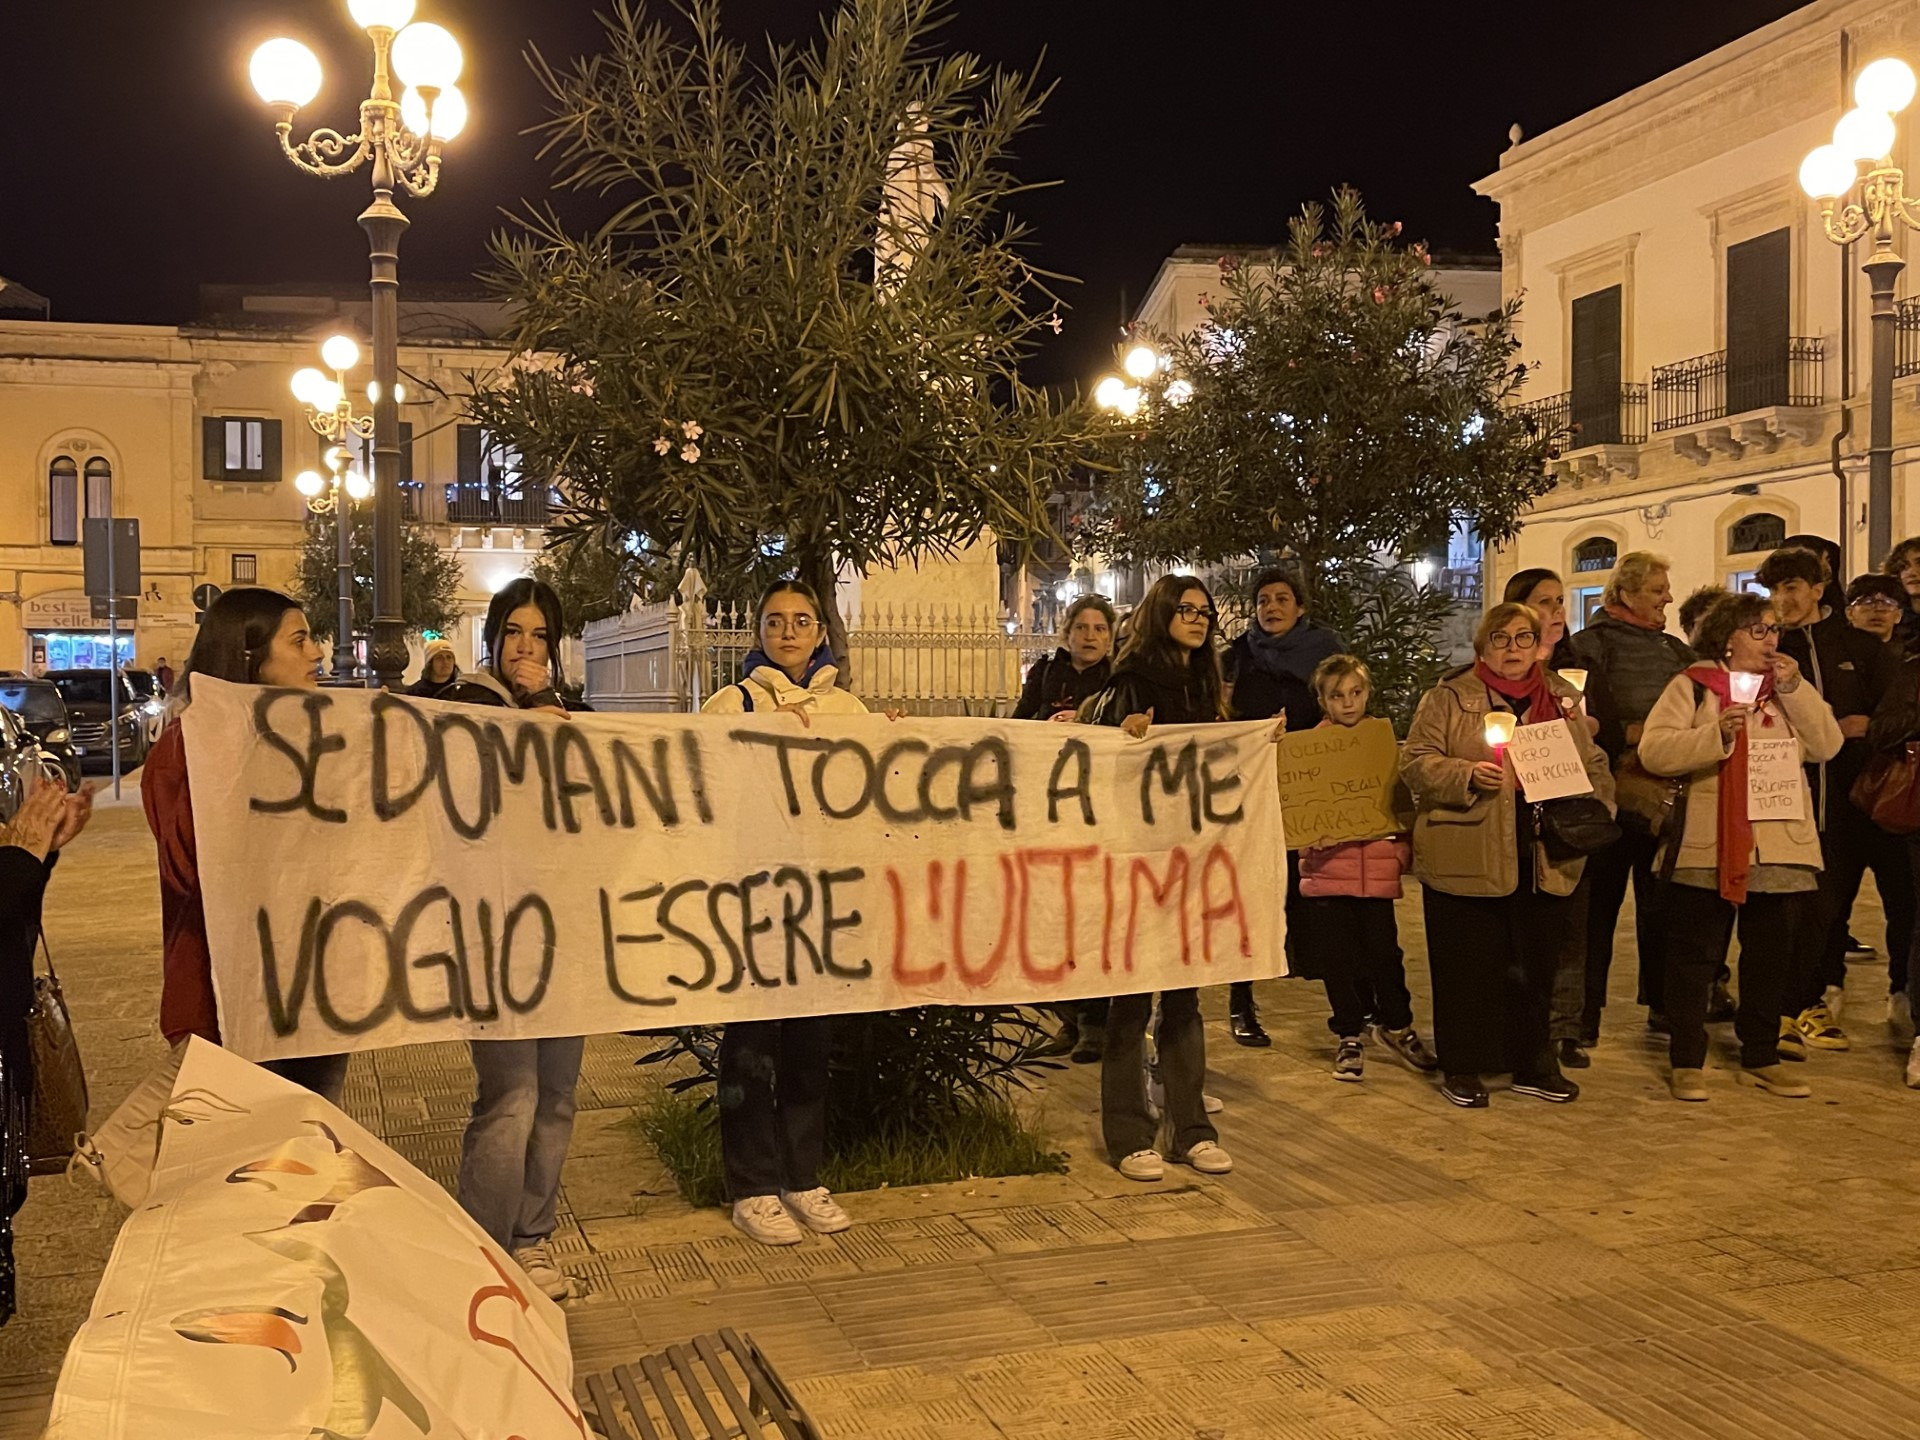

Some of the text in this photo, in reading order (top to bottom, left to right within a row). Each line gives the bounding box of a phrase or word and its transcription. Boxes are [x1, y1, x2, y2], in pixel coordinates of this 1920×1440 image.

[30, 601, 66, 613] best
[53, 614, 100, 627] seller
[1283, 736, 1361, 759] IOLENZA
[1514, 746, 1550, 762] VERO
[249, 687, 1245, 840] SE DOMANI TOCCA A ME
[1520, 769, 1540, 784] NON
[1330, 776, 1382, 796] DEGLI
[1754, 795, 1793, 810] TUTTO
[1282, 807, 1371, 838] NCAPACI
[258, 843, 1253, 1037] VOGLIO ESSERE L'ULTIMA
